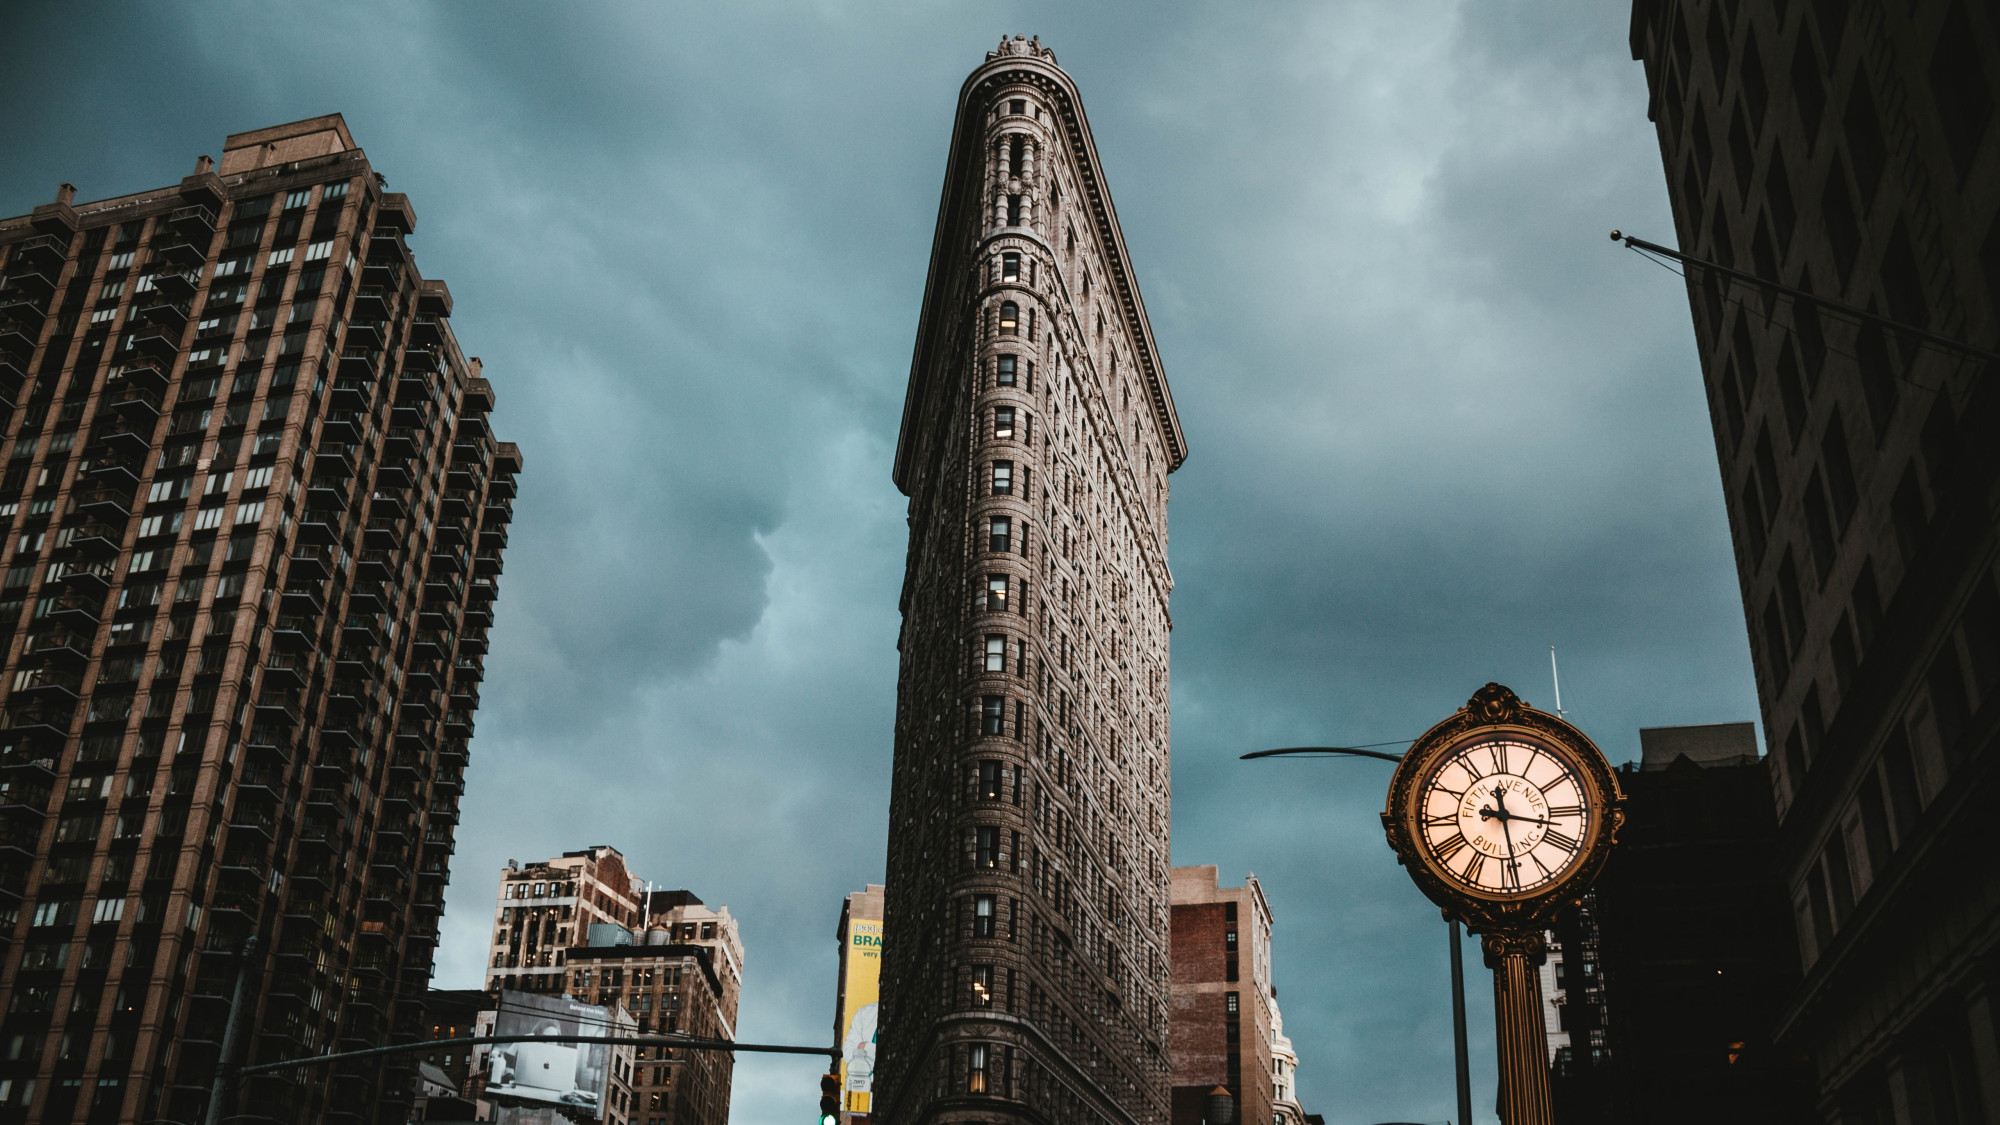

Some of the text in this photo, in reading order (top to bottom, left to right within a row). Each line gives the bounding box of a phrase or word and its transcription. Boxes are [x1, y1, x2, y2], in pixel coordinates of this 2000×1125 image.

[1462, 779, 1544, 818] FIFTH AVENUE
[854, 923, 877, 935] (833)
[853, 935, 882, 946] BRA
[863, 951, 878, 959] very
